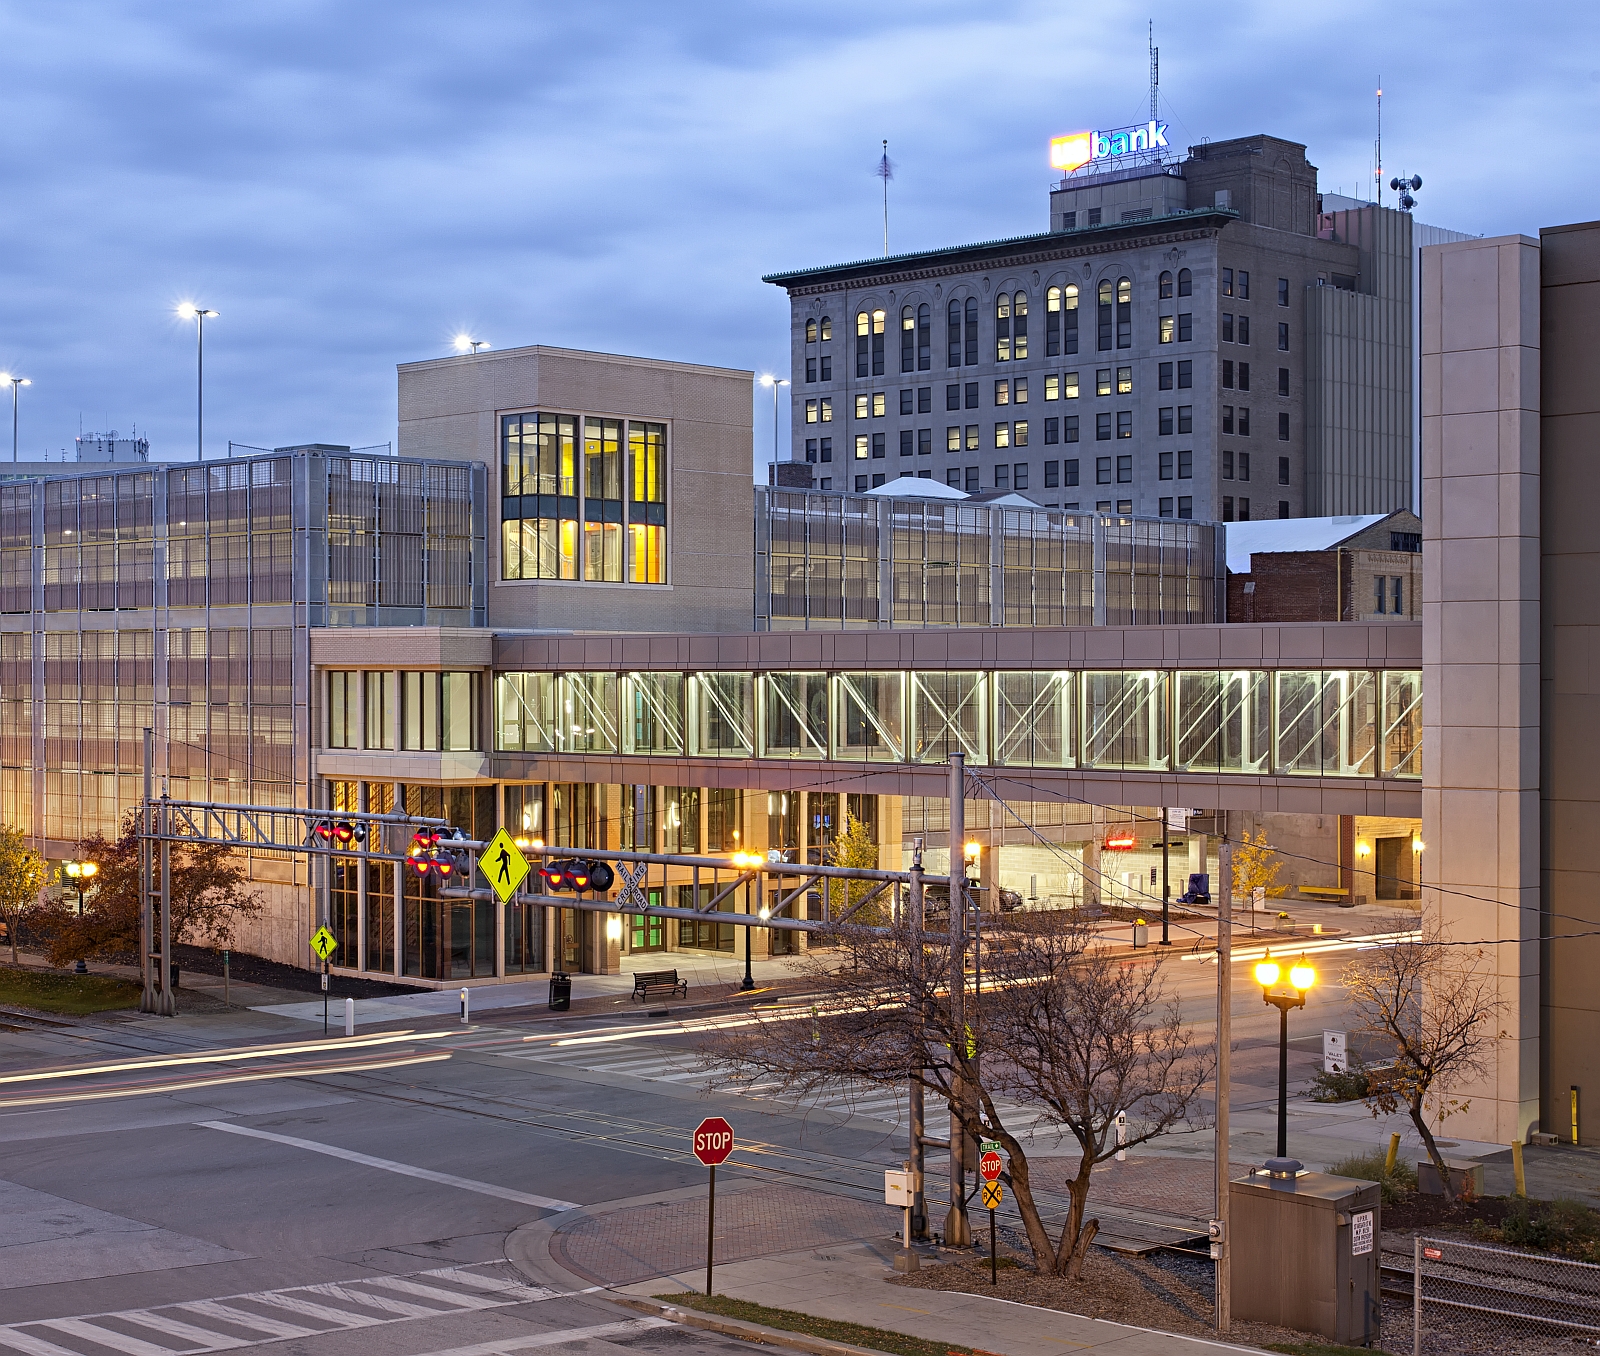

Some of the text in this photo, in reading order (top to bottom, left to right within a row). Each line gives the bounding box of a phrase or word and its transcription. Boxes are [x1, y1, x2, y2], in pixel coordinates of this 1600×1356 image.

[617, 865, 646, 905] CROSSING
[1325, 1055, 1345, 1064] PARKING
[696, 1132, 731, 1151] STOP
[981, 1160, 1001, 1173] STOP
[983, 1189, 1001, 1200] R R
